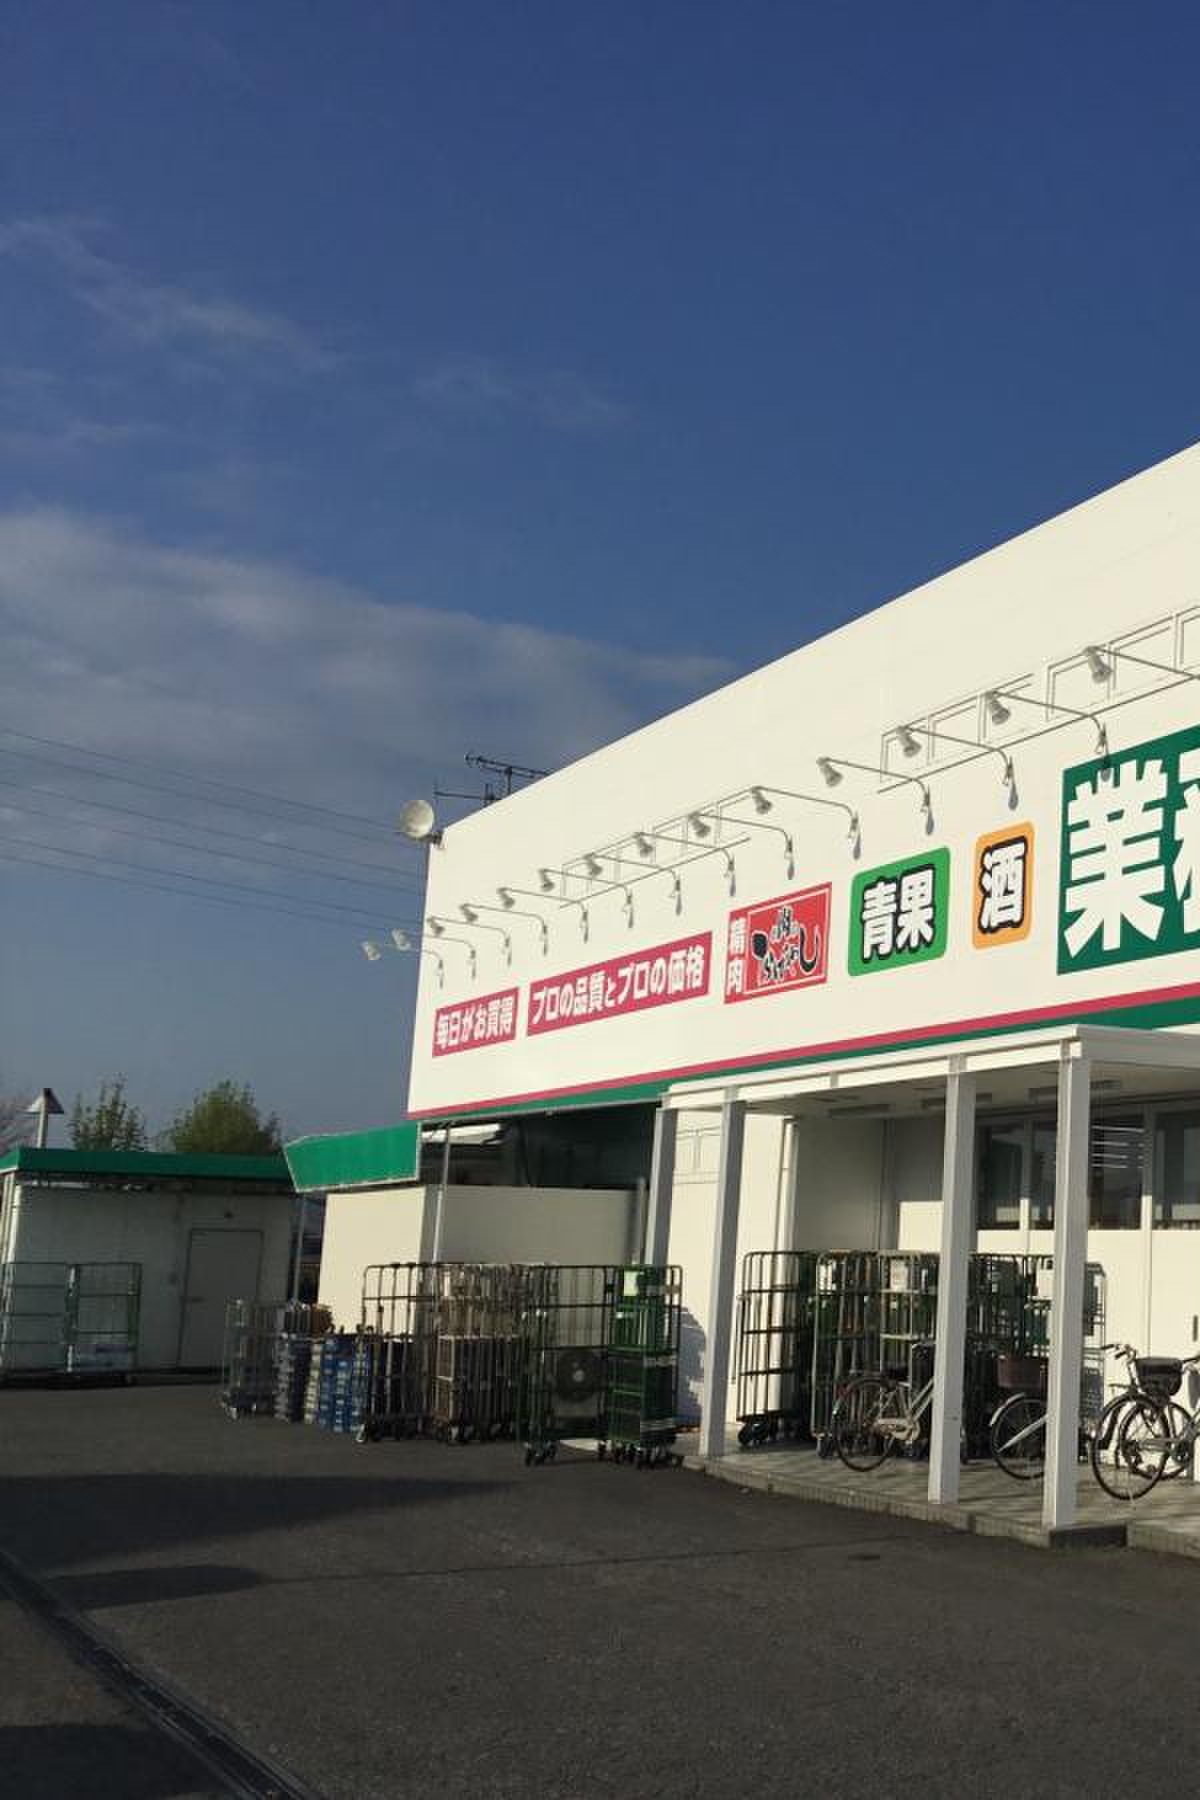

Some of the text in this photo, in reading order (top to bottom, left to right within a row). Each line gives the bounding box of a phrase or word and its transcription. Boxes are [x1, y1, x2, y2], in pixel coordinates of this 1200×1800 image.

[861, 866, 935, 962] 青果
[978, 839, 1027, 931] 酒
[436, 996, 513, 1050] 毎日がお買得
[531, 944, 705, 1025] プロの品質とプロの価格
